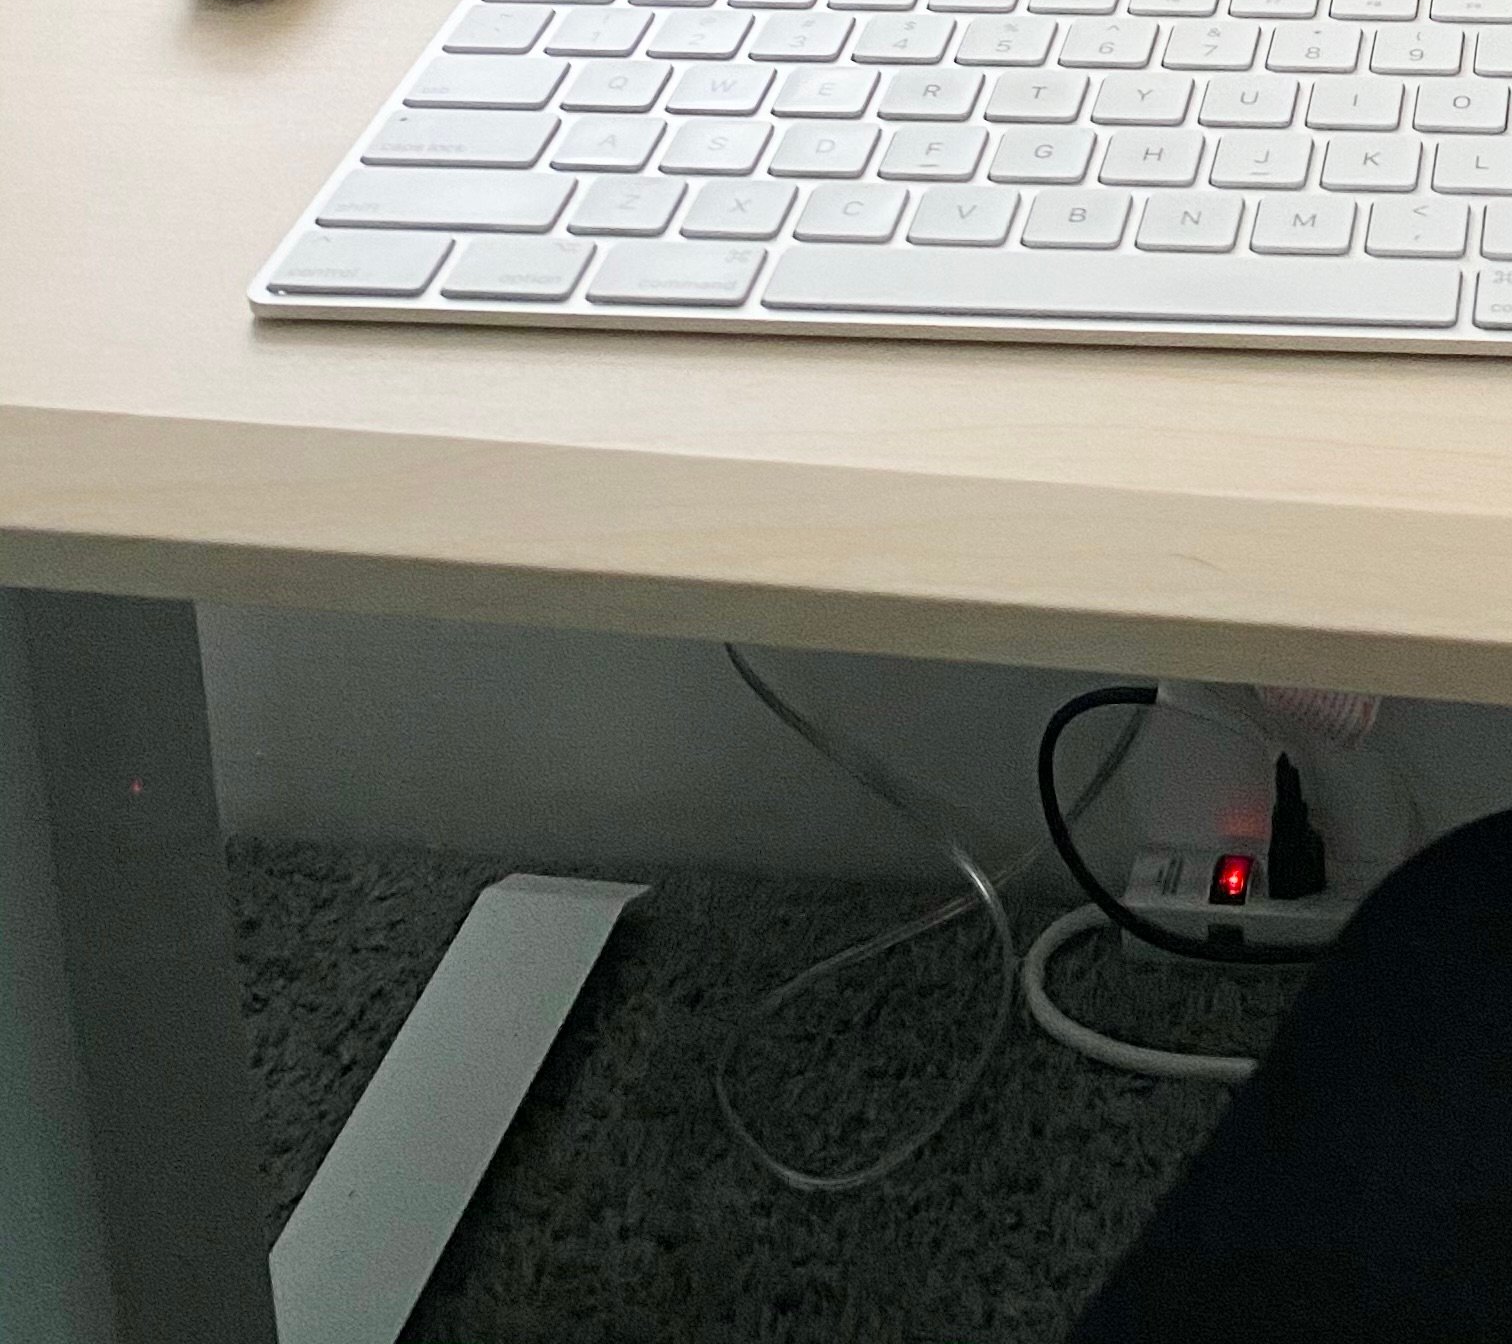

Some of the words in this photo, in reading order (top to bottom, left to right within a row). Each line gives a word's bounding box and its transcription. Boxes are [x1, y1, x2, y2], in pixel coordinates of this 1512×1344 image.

[688, 33, 706, 46] 2
[789, 35, 808, 48] 3
[892, 38, 908, 49] 4
[996, 40, 1012, 52] 5
[1098, 42, 1114, 54] 6
[1204, 44, 1218, 56] 7
[1305, 47, 1320, 59] 8
[1409, 49, 1424, 61] 9
[608, 76, 628, 91] Q
[711, 80, 737, 92] W
[818, 83, 835, 96] E
[923, 84, 941, 97] R
[1033, 86, 1047, 99] T
[1137, 89, 1153, 101] Y
[1240, 92, 1259, 105] U
[598, 134, 617, 148] A
[707, 137, 728, 151] S
[815, 139, 836, 154] D
[925, 142, 943, 155] F
[1034, 144, 1053, 159] G
[1143, 148, 1163, 161] H
[1254, 150, 1270, 164] J
[1363, 153, 1379, 166] K
[1475, 156, 1488, 169] L
[616, 194, 641, 210] Z
[730, 199, 751, 213] X
[842, 201, 864, 216] C
[957, 205, 977, 219] V
[1068, 208, 1087, 223] B
[1181, 211, 1201, 225] N
[1293, 214, 1317, 227] M
